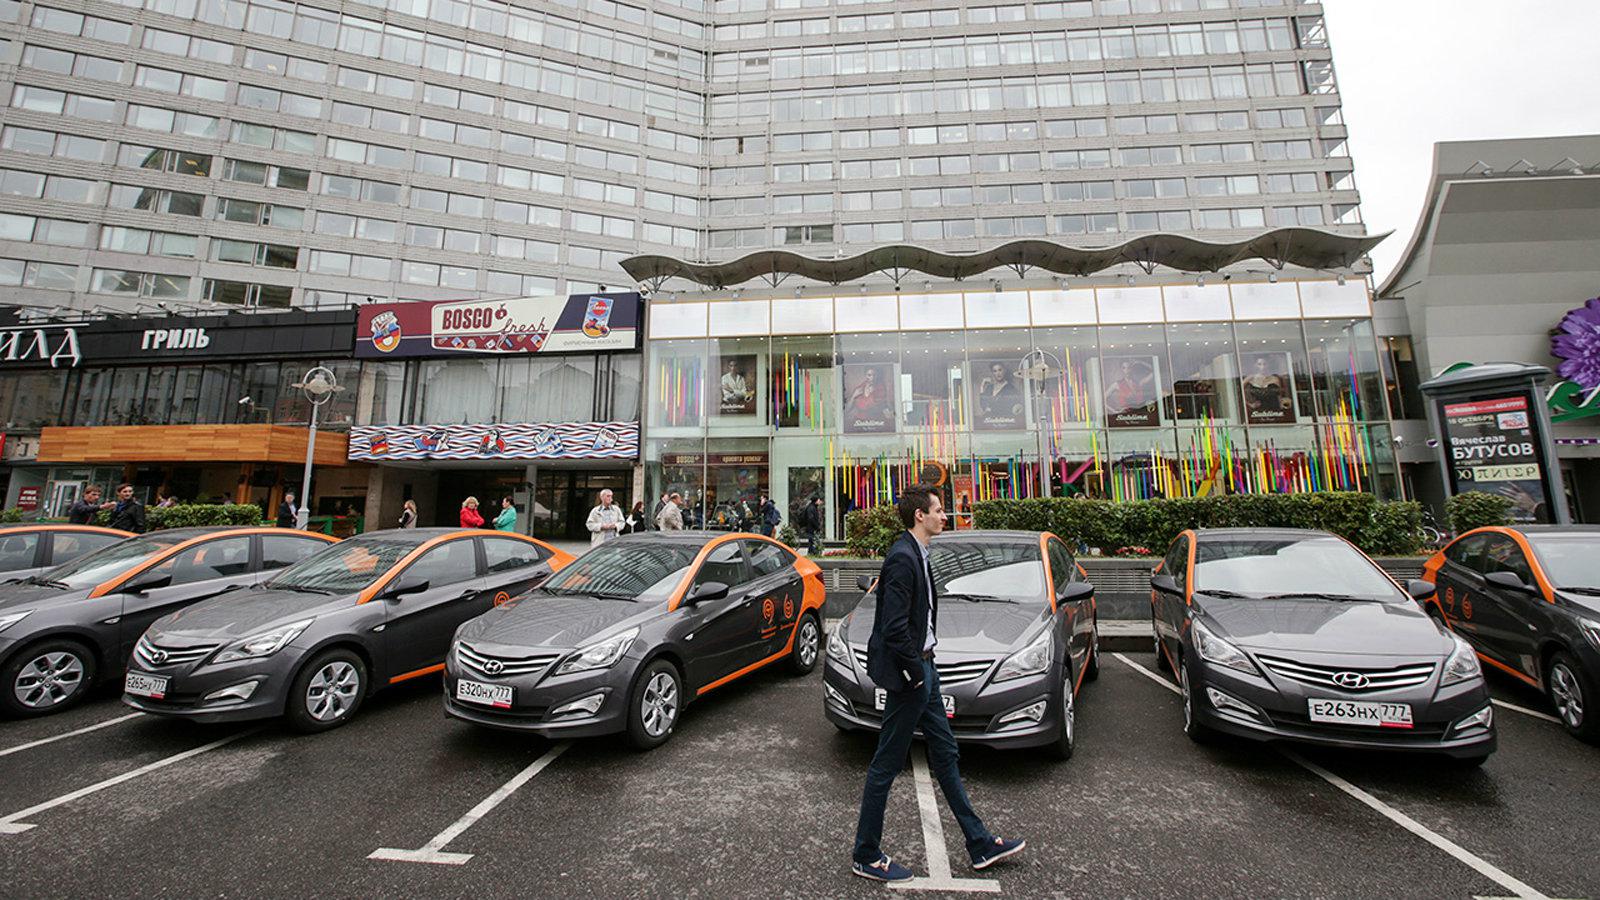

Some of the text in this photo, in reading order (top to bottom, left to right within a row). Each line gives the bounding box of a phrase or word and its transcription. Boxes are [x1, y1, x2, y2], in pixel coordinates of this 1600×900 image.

[442, 307, 493, 330] BOSCO
[140, 328, 210, 350] ГРИЛЬ
[496, 317, 550, 348] fresh
[1251, 410, 1285, 418] Sublime
[853, 419, 886, 427] Sublime
[1451, 435, 1506, 446] Вячеслав
[1453, 442, 1534, 460] БУТУСОВ
[496, 686, 510, 698] 777
[1381, 704, 1406, 717] 777
